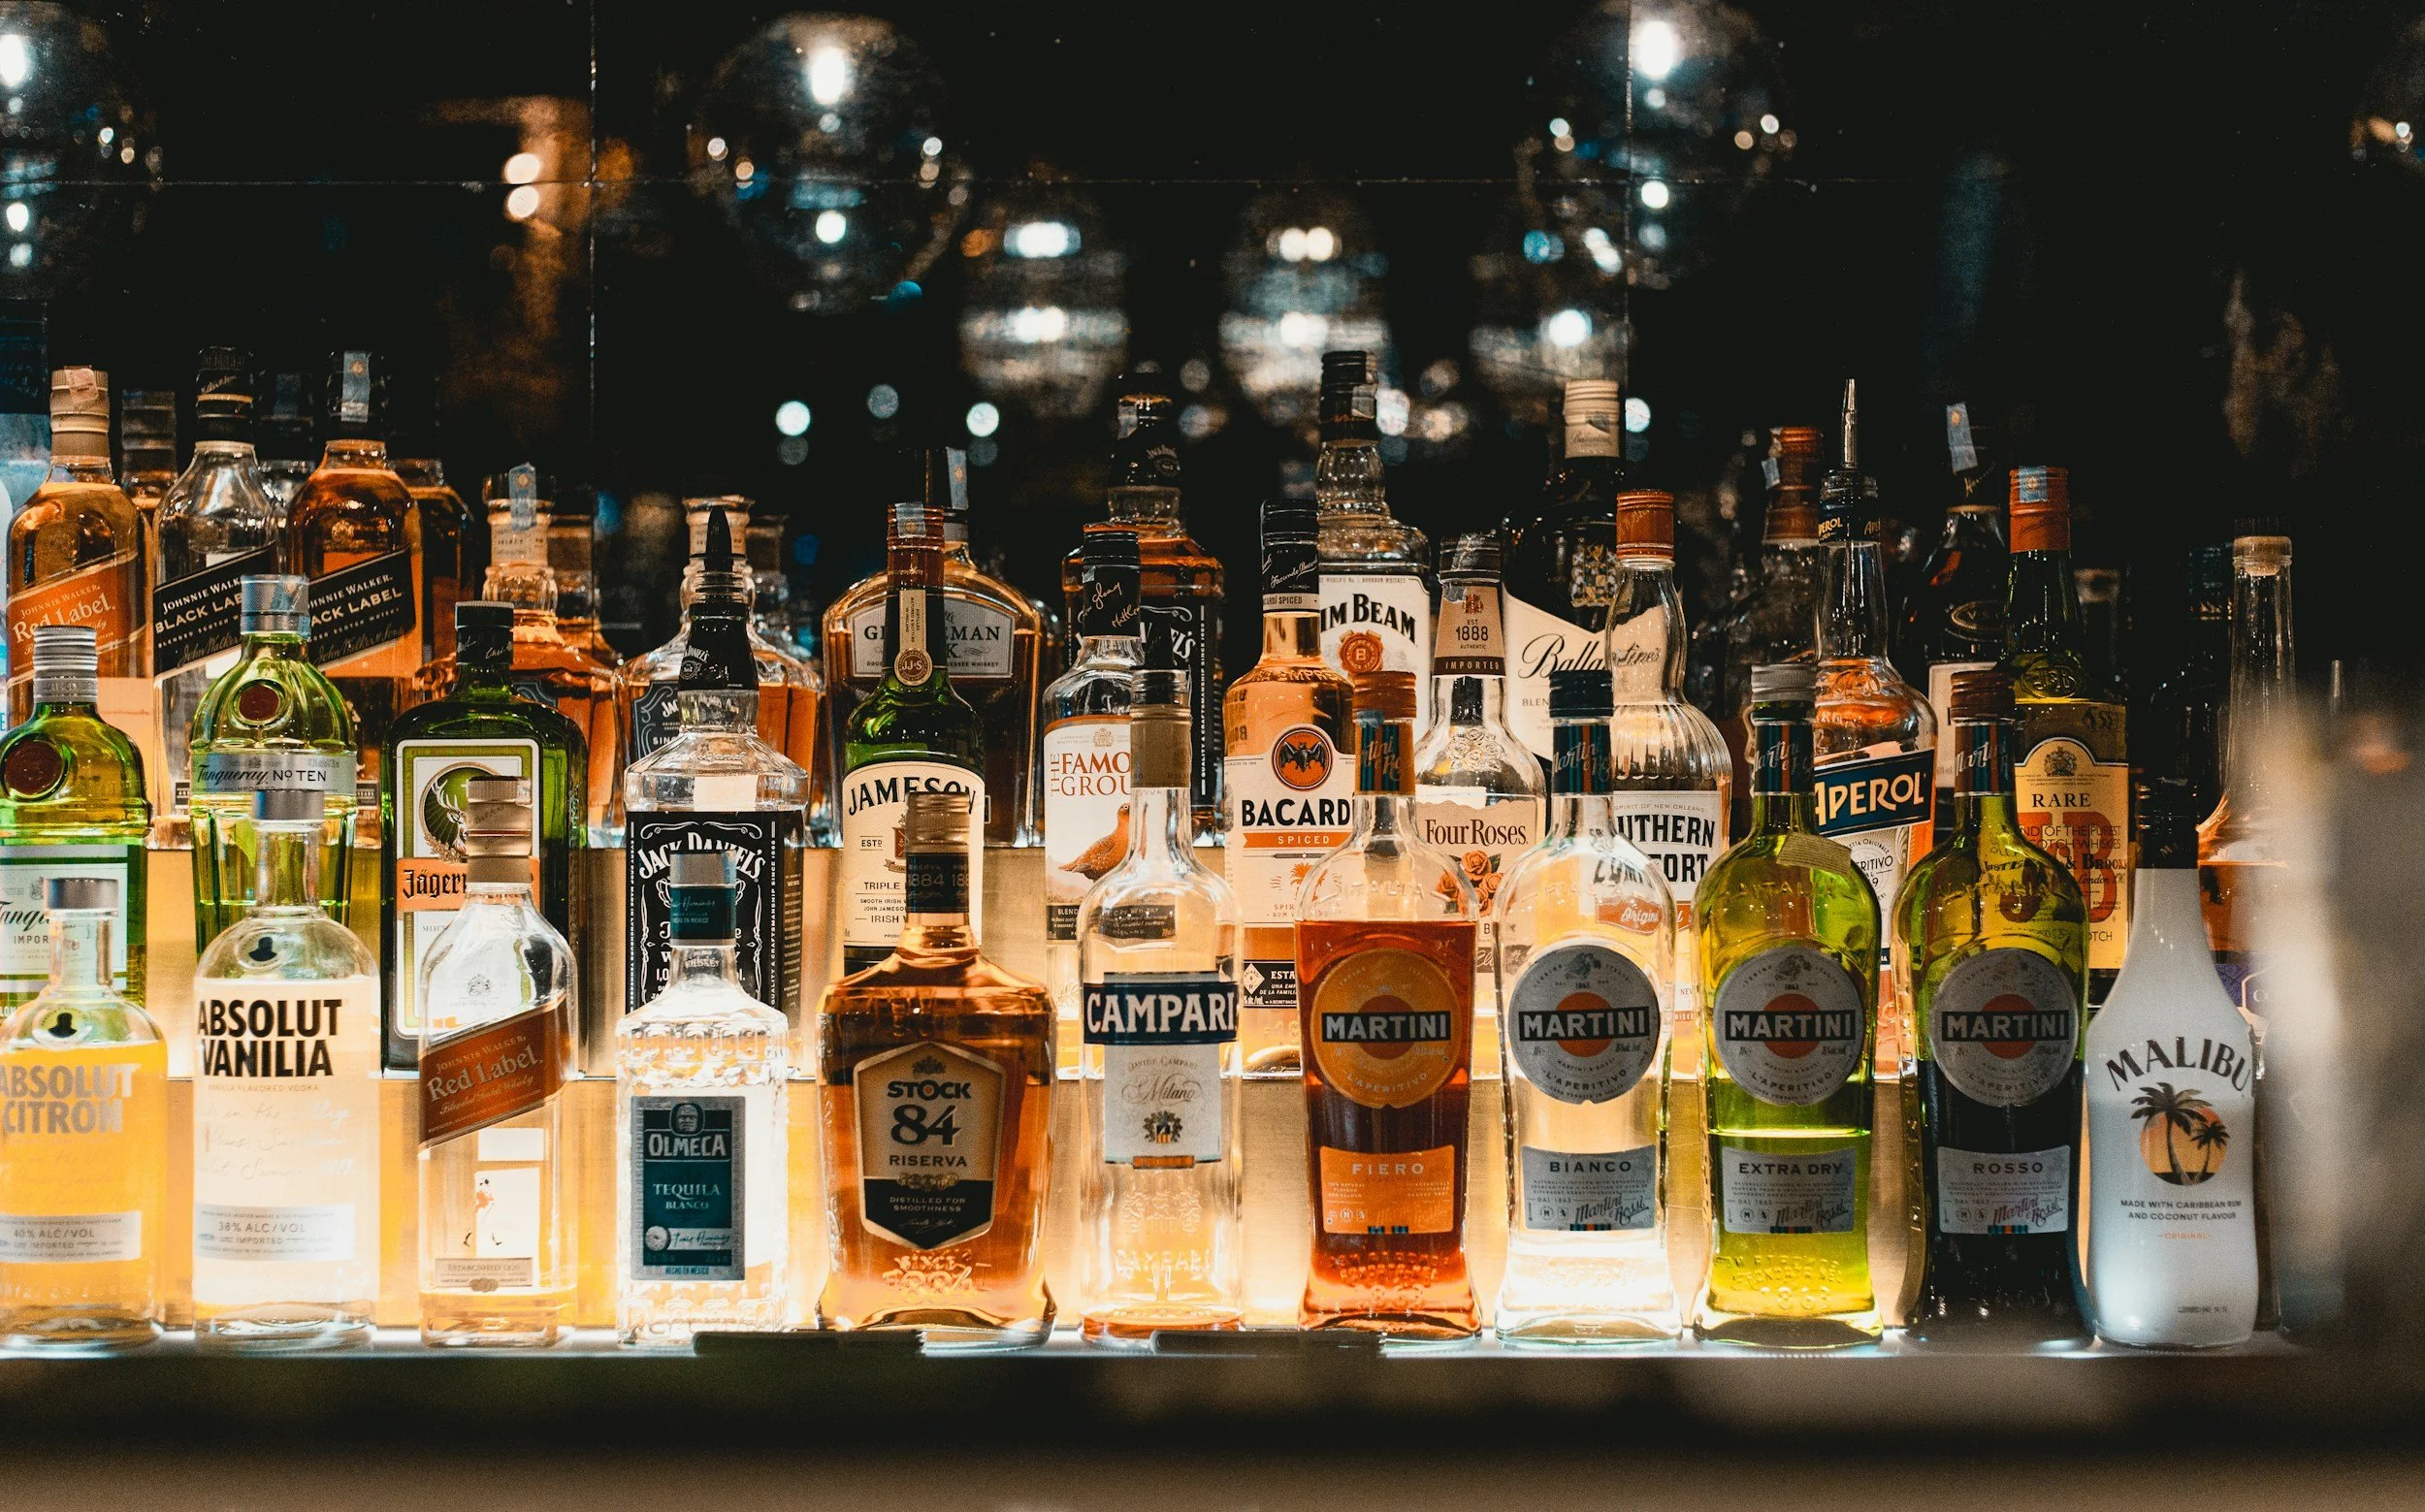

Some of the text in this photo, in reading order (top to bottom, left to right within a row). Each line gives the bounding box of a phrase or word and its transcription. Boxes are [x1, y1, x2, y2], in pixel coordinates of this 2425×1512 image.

[162, 576, 242, 615] JOHNNIE WALK
[309, 593, 344, 609] HNNIE
[1277, 595, 1303, 605] SPICED
[20, 598, 62, 620] JOHNNIE
[155, 592, 242, 633] BLACK LAB
[310, 587, 402, 627] ACK LABEL
[13, 613, 52, 644] Red
[197, 618, 229, 634] SCOTCH
[1320, 593, 1417, 645] IM BEAM
[1455, 626, 1490, 641] 1888
[1444, 660, 1500, 670] IMPORTED
[1522, 697, 1549, 707] BLEN
[1060, 751, 1131, 775] FAMO
[296, 770, 327, 782] TEN
[1672, 804, 1705, 814] ORLEANS
[2031, 792, 2091, 808] RARE
[1241, 797, 1355, 827] BACARD
[1277, 834, 1331, 845] SPICED
[1425, 818, 1471, 846] Four
[1617, 814, 1716, 849] UTHERN
[2043, 825, 2062, 836] OF
[2064, 825, 2088, 836] THE
[863, 882, 900, 890] TRIPLE
[871, 915, 899, 923] IRISH
[14, 935, 49, 945] IMPOR
[198, 998, 343, 1039] ABSOLUT
[1086, 992, 1236, 1034] CAMPARI
[1325, 1013, 1447, 1040] MARTINI
[1523, 1010, 1646, 1039] MARTINI
[1729, 1013, 1852, 1039] MARTINI
[1946, 1013, 2066, 1040] MARTINI
[201, 1039, 334, 1078] VANILIA
[436, 1051, 481, 1076] JOHNNIE
[2105, 1035, 2252, 1092] MALIBU
[0, 1063, 142, 1099] ABSOLUT
[427, 1066, 475, 1103] Red
[887, 1079, 972, 1102] STOCK
[1122, 1073, 1204, 1107] Milano
[1546, 1069, 1628, 1091] L'APERITIVO
[1751, 1071, 1833, 1093] L'APERITIVO
[3, 1098, 124, 1134] CITRON
[890, 1104, 962, 1147] 84
[648, 1133, 727, 1157] OLMECA
[889, 1154, 968, 1168] RISERVA
[1351, 1163, 1425, 1175] FIERO
[1549, 1161, 1633, 1174] BIANCO
[1738, 1163, 1845, 1175] EXTRA DRY
[1972, 1162, 2044, 1174] ROSSO
[653, 1182, 721, 1201] TEQUILA
[889, 1196, 966, 1205] DISTILLED FOR
[665, 1200, 710, 1210] BLANCO
[1573, 1191, 1623, 1226] Martini
[2120, 1199, 2243, 1209] MADE WITH CARIBBEAN RUM
[217, 1221, 242, 1233] 38%
[2128, 1211, 2238, 1221] AND COCONUT FLAVOUR
[235, 1237, 284, 1245] IMPORTED
